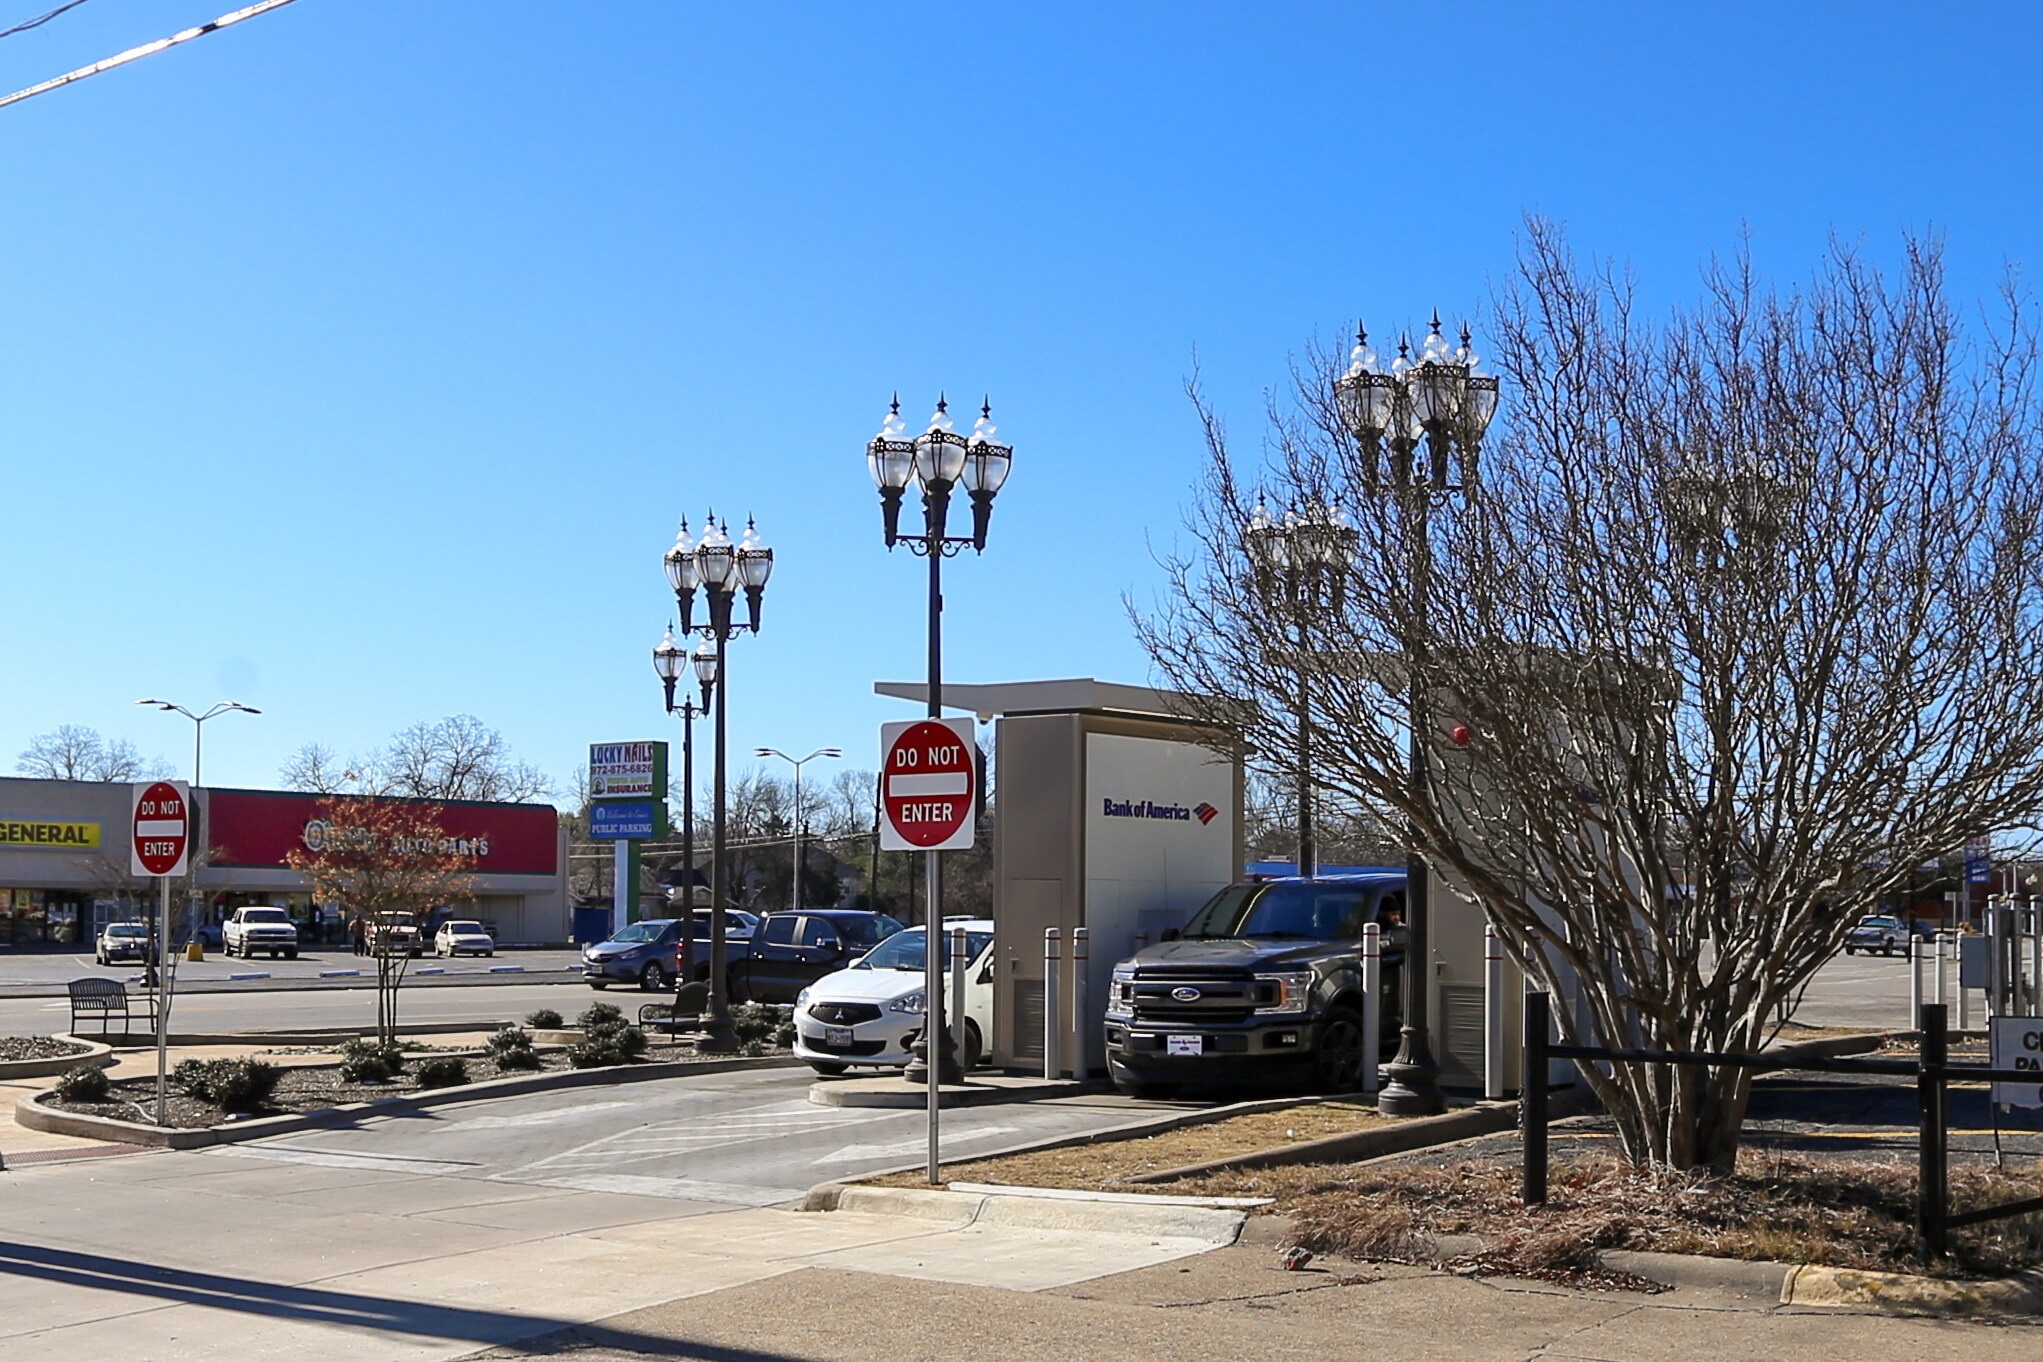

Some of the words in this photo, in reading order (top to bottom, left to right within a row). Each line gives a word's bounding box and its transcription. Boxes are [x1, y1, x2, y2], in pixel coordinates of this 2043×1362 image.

[624, 743, 653, 763] NAILS
[896, 748, 918, 767] DO
[928, 746, 960, 765] NOT
[607, 783, 653, 794] INSURANCE
[142, 801, 155, 815] DO
[160, 800, 180, 815] NOT
[902, 803, 953, 823] ENTER
[1104, 798, 1133, 817] Bank
[1134, 800, 1146, 818] of
[1146, 801, 1190, 820] America
[0, 823, 89, 844] GENERAL
[592, 824, 618, 833] PUBLIC
[619, 823, 652, 833] PARKING
[144, 842, 175, 856] ENTER
[438, 837, 489, 856] PARTS
